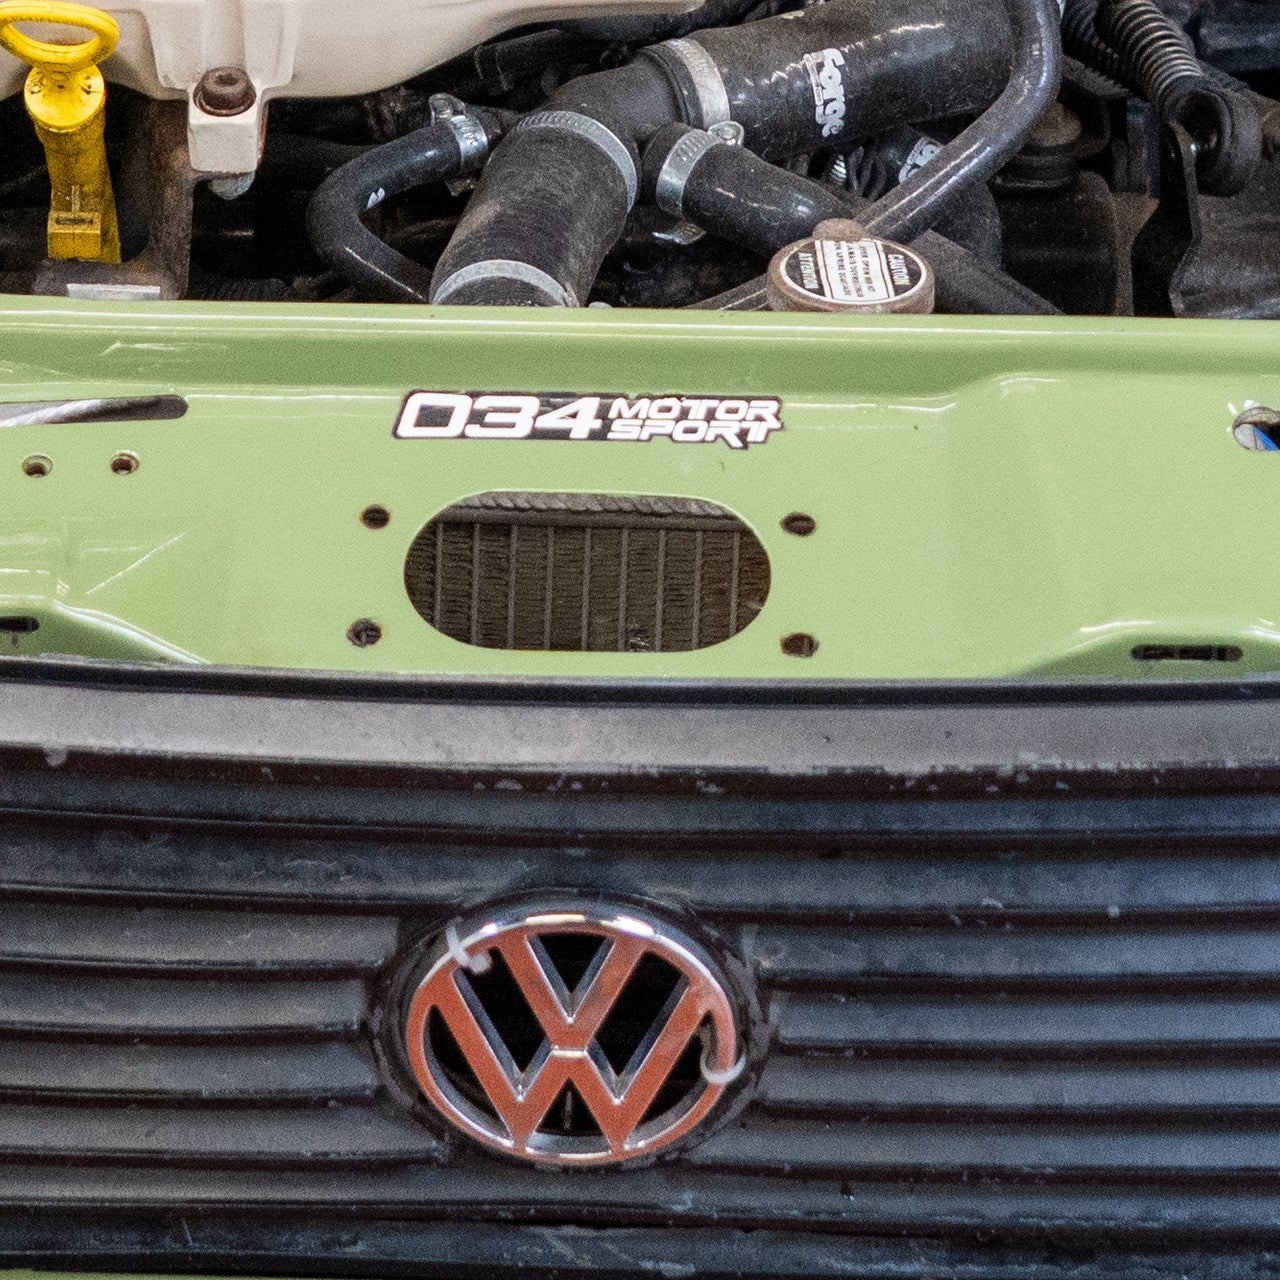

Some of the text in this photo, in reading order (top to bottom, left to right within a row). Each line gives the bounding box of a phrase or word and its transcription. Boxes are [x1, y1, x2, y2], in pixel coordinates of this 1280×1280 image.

[887, 254, 911, 286] CAUTION
[396, 392, 603, 440] 034
[607, 397, 780, 425] MOTOR
[607, 420, 774, 449] SPORT
